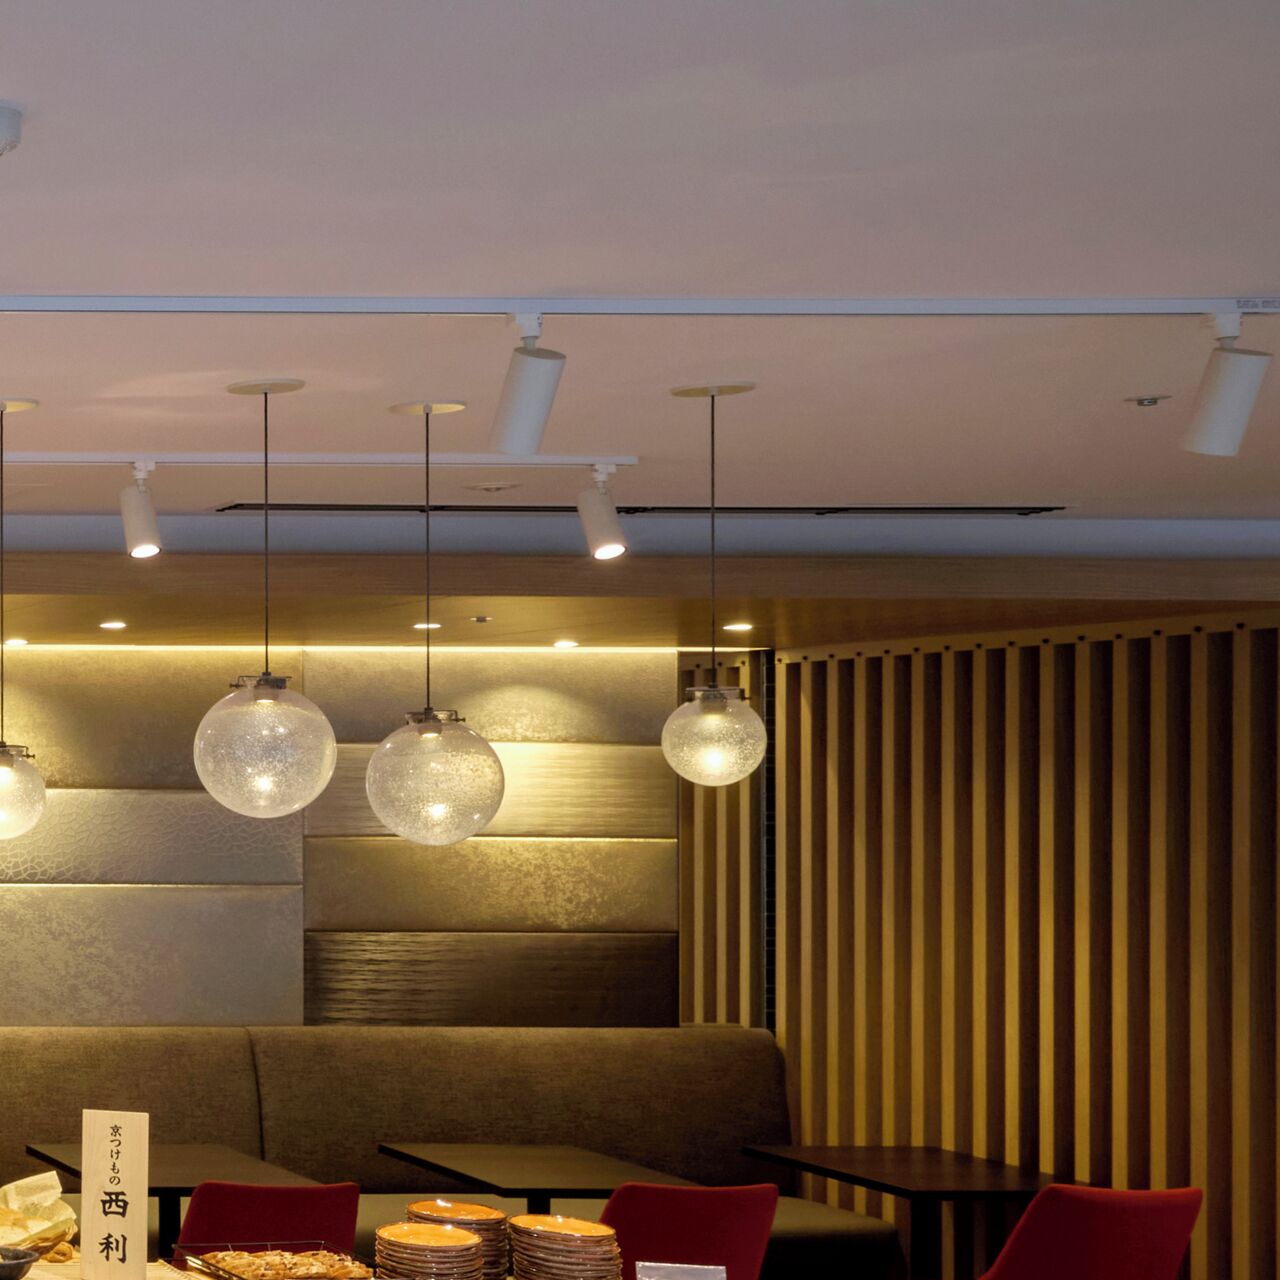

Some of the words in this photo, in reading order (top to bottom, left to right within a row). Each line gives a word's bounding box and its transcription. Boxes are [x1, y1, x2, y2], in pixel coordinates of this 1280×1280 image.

[109, 1124, 122, 1185] 京つけもの
[99, 1191, 130, 1264] 西利
